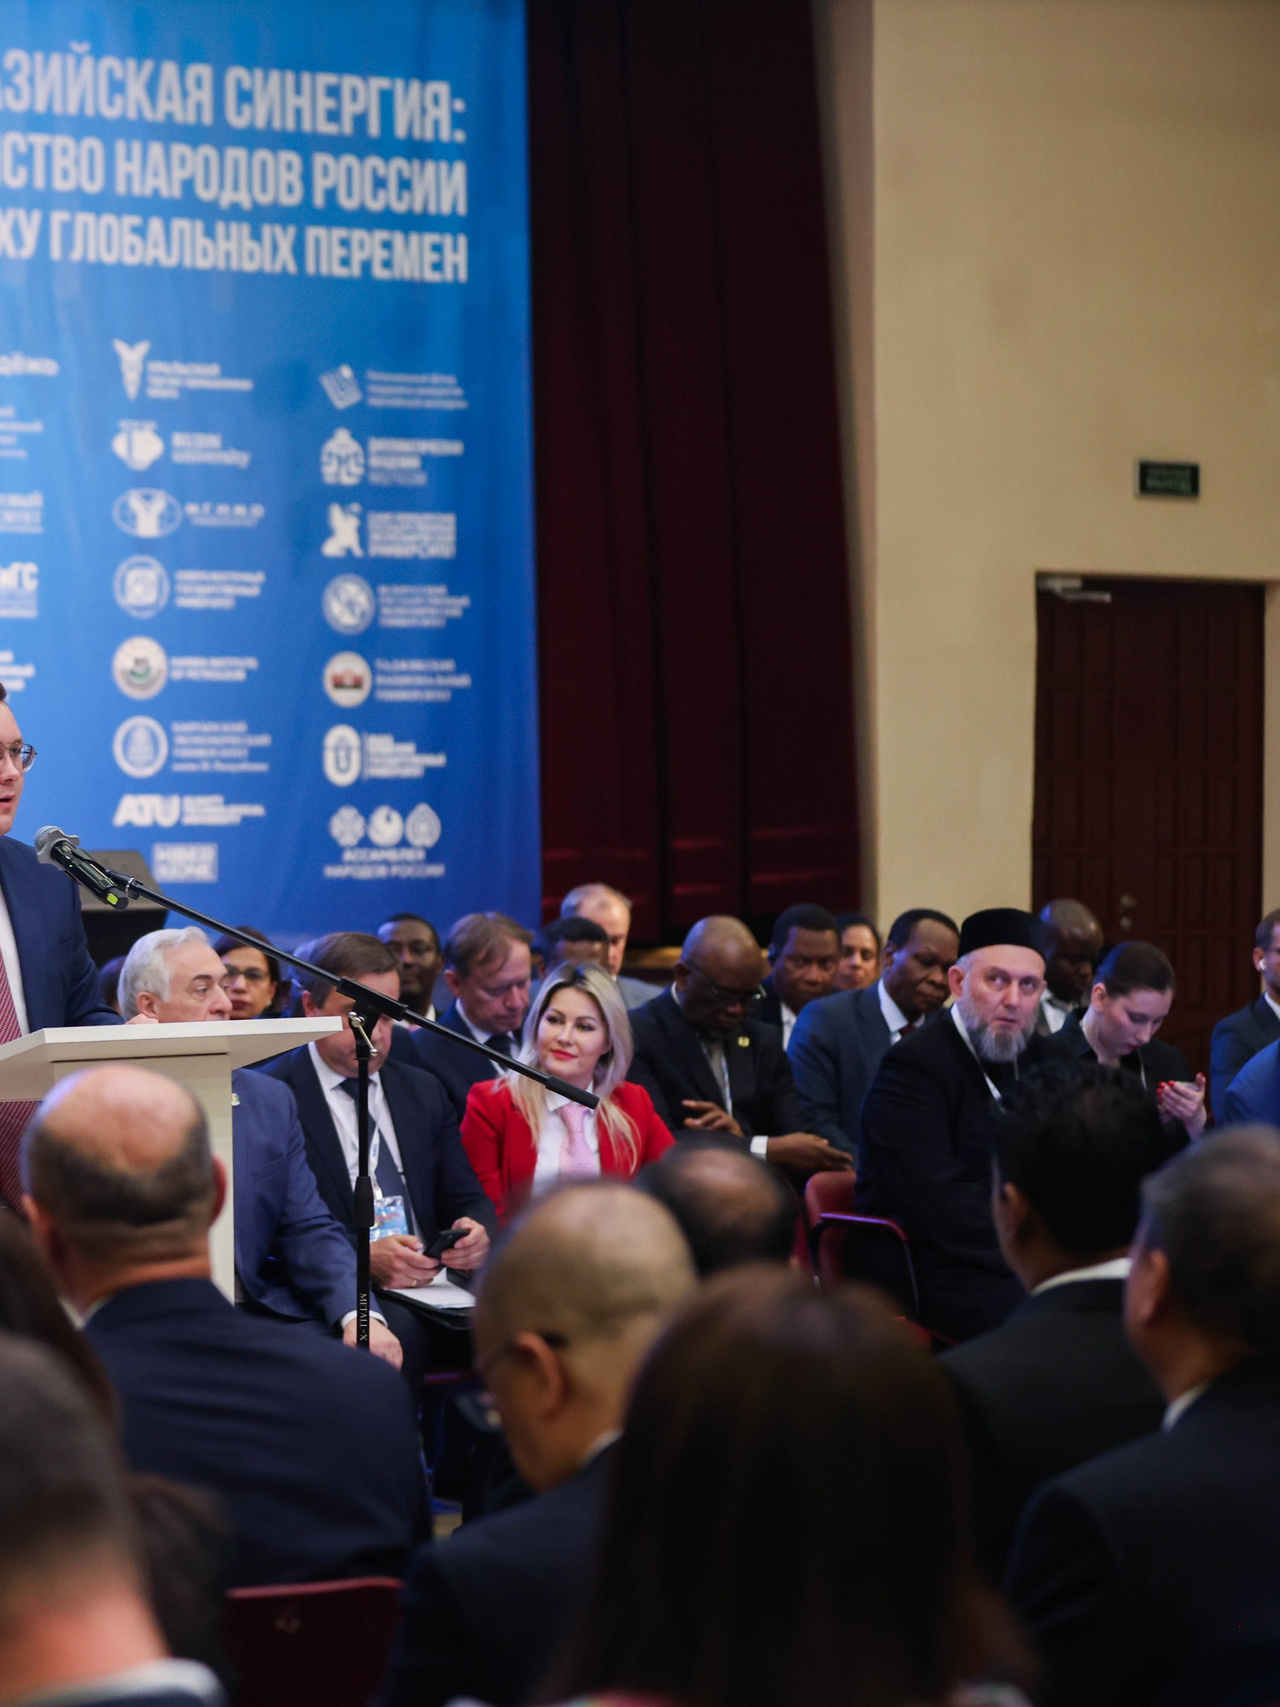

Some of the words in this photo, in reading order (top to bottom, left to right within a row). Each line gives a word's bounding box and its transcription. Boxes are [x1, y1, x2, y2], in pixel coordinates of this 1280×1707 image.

[224, 66, 467, 143] СИНЕРГИЯ:
[116, 139, 304, 209] НАРОДОВ
[313, 154, 468, 216] РОССИИ
[49, 211, 298, 275] ГЛОБАЛЬНЫХ
[305, 226, 468, 283] ПЕРЕМЕН
